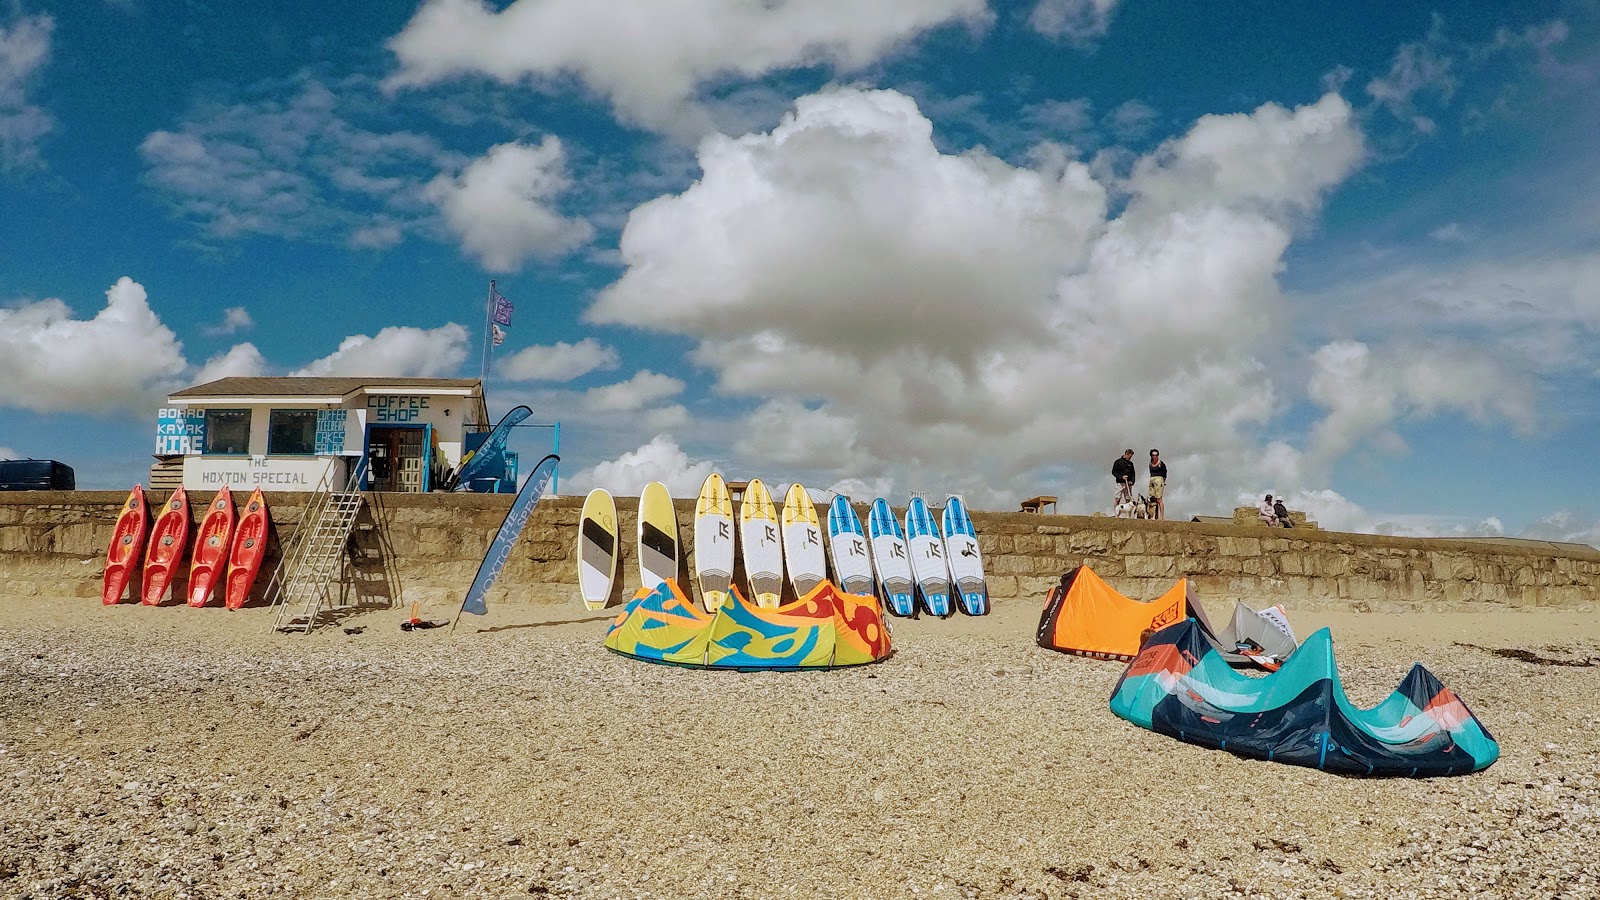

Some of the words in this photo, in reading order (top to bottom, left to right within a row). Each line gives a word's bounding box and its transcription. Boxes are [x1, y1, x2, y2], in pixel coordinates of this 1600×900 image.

[367, 395, 430, 408] COFFEE
[158, 408, 206, 418] BOARD
[317, 409, 347, 421] COFFEE
[377, 408, 419, 421] SHOP
[157, 423, 204, 435] KAYAK
[315, 431, 345, 443] CAKES
[155, 435, 204, 454] HIRE
[314, 443, 345, 455] SALAD
[247, 458, 268, 467] THE
[202, 472, 247, 484] HOXTON
[252, 472, 308, 484] SPECIAL
[517, 469, 552, 530] SPECIAL
[496, 509, 519, 543] THE
